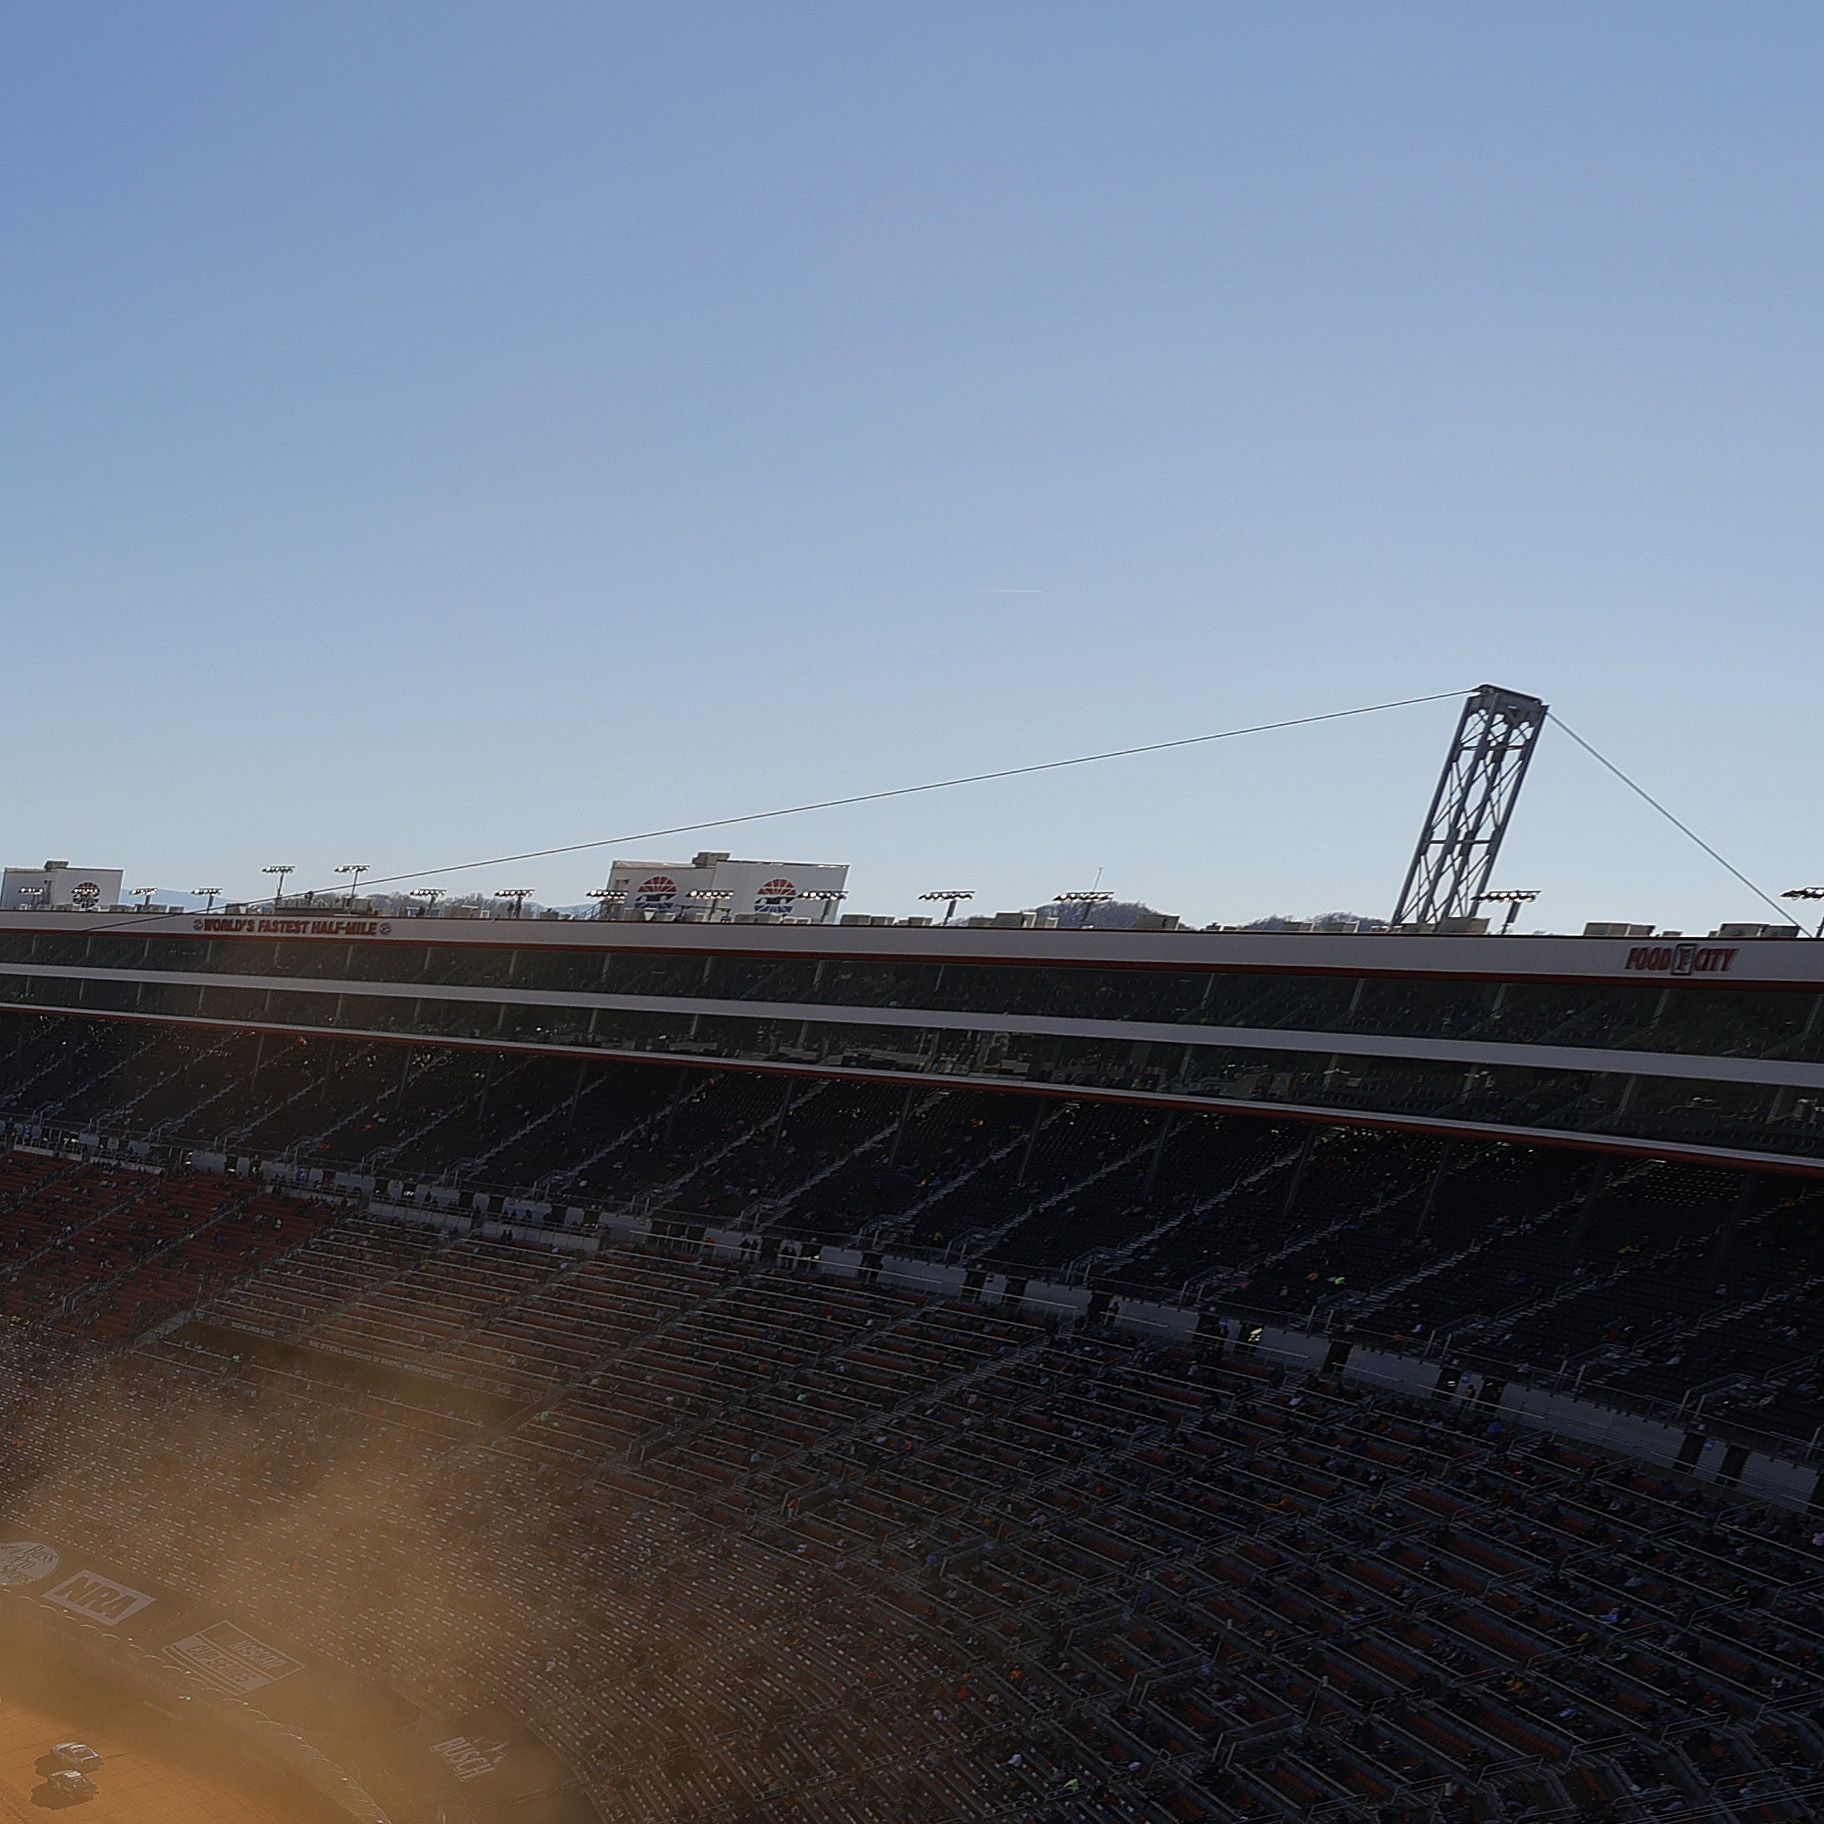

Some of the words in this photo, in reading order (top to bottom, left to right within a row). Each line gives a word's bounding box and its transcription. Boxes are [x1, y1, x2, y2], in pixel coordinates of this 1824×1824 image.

[204, 917, 255, 932] WORLD'S
[258, 919, 309, 934] FASTEST
[311, 921, 376, 935] HALF-MILE
[1624, 946, 1671, 970] FOOD
[1694, 947, 1740, 971] CITY
[64, 1573, 136, 1620] NRA
